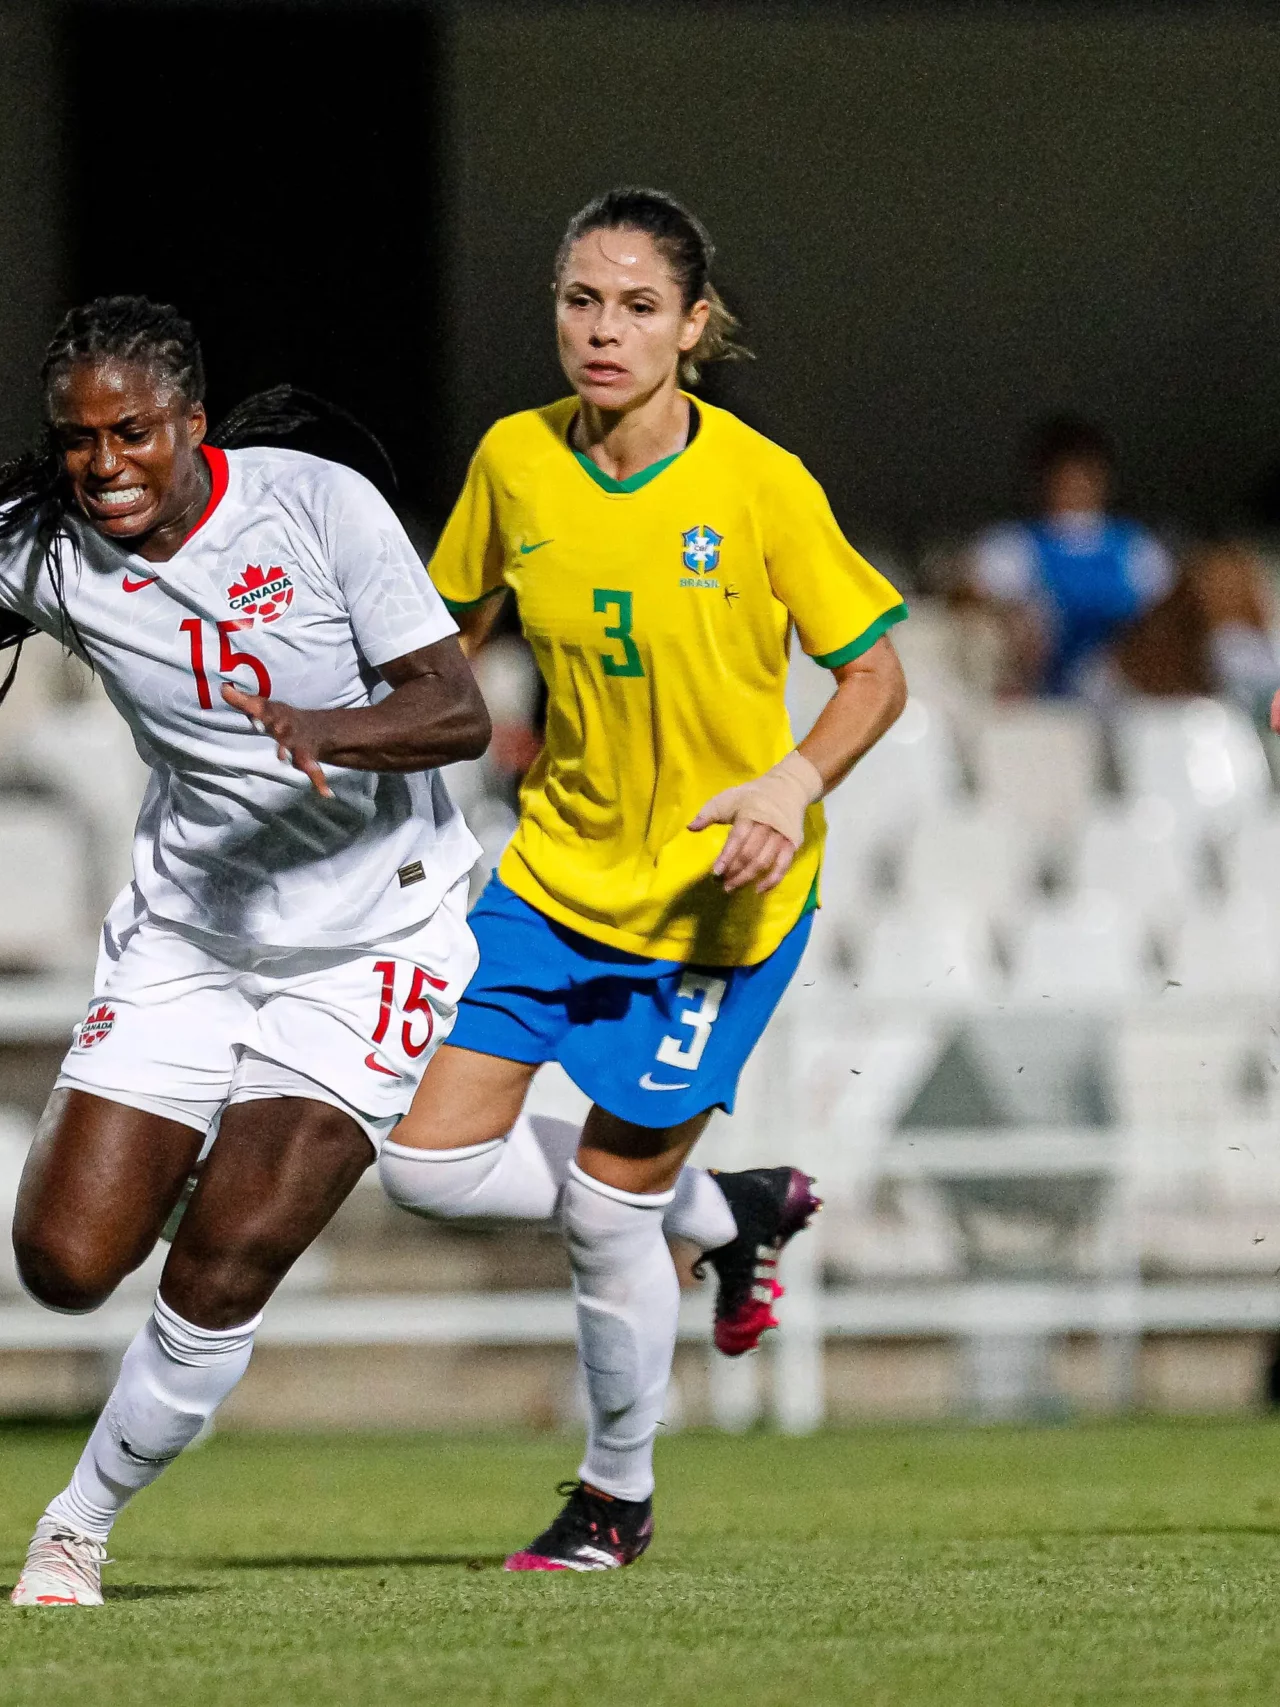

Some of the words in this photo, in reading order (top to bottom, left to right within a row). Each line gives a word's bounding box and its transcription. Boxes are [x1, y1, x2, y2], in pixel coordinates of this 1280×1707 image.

[228, 577, 293, 610] CANADA
[679, 578, 719, 588] BRASIL
[179, 617, 272, 710] 15
[593, 588, 645, 678] 3
[81, 1022, 113, 1034] CANADA
[371, 961, 449, 1058] 15
[656, 971, 727, 1071] 3
